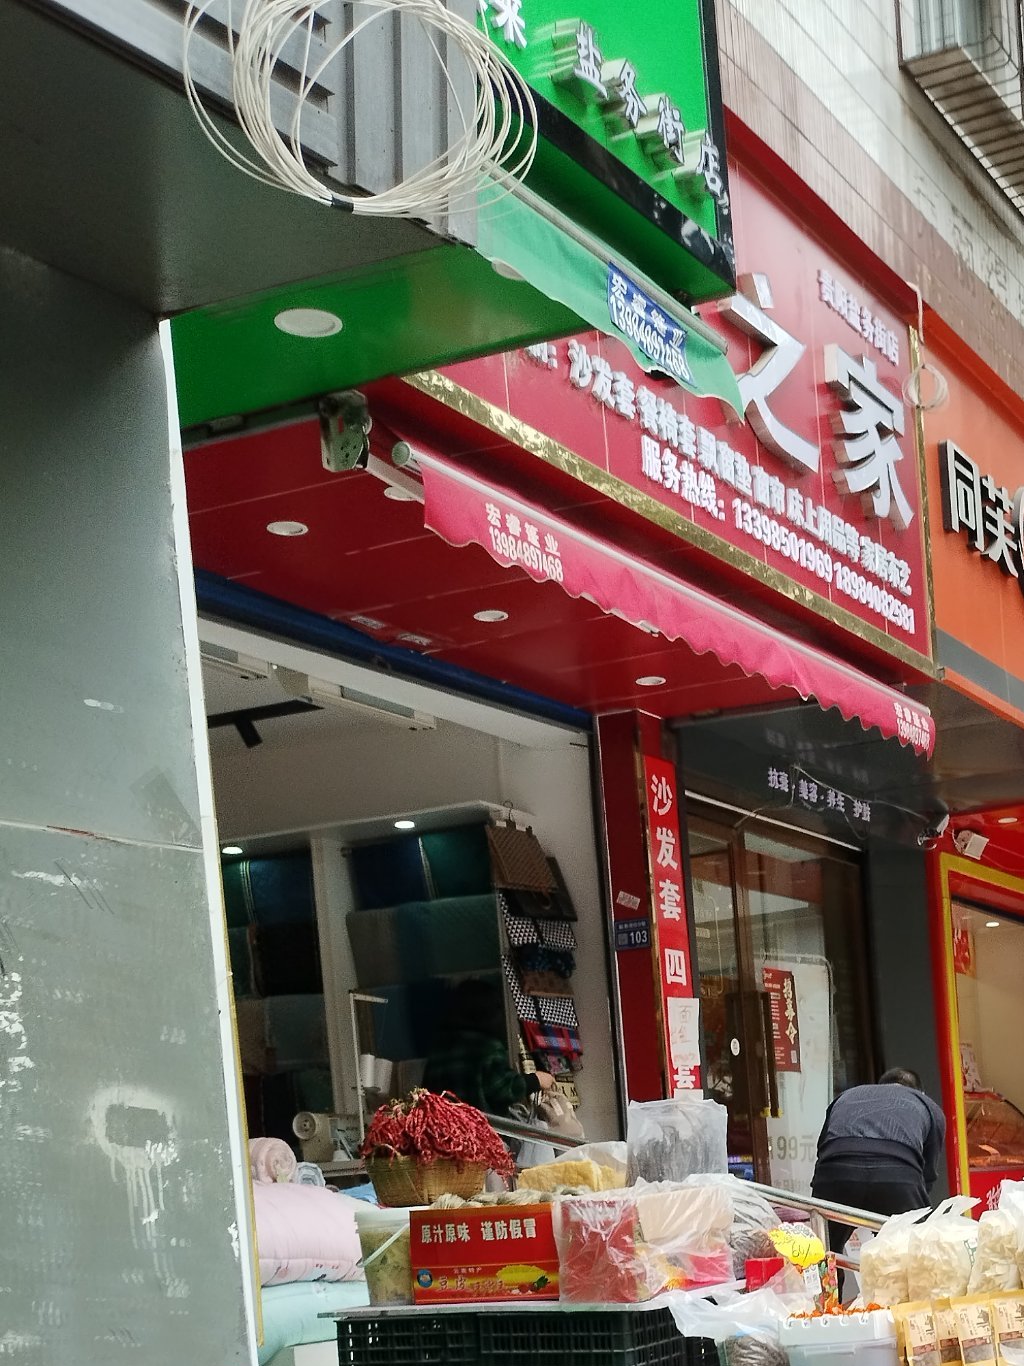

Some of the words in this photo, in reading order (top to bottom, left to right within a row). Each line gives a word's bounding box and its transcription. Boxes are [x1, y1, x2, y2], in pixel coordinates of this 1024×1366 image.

[573, 18, 729, 200] 盐务街店
[568, 338, 636, 420] 沙发套
[786, 487, 860, 563] 床上用品等
[731, 497, 834, 584] 13398501969
[650, 774, 682, 921] 沙发套
[629, 930, 648, 944] 103
[421, 1222, 470, 1243] 原汁原味
[480, 1218, 537, 1241] 谨防假冒
